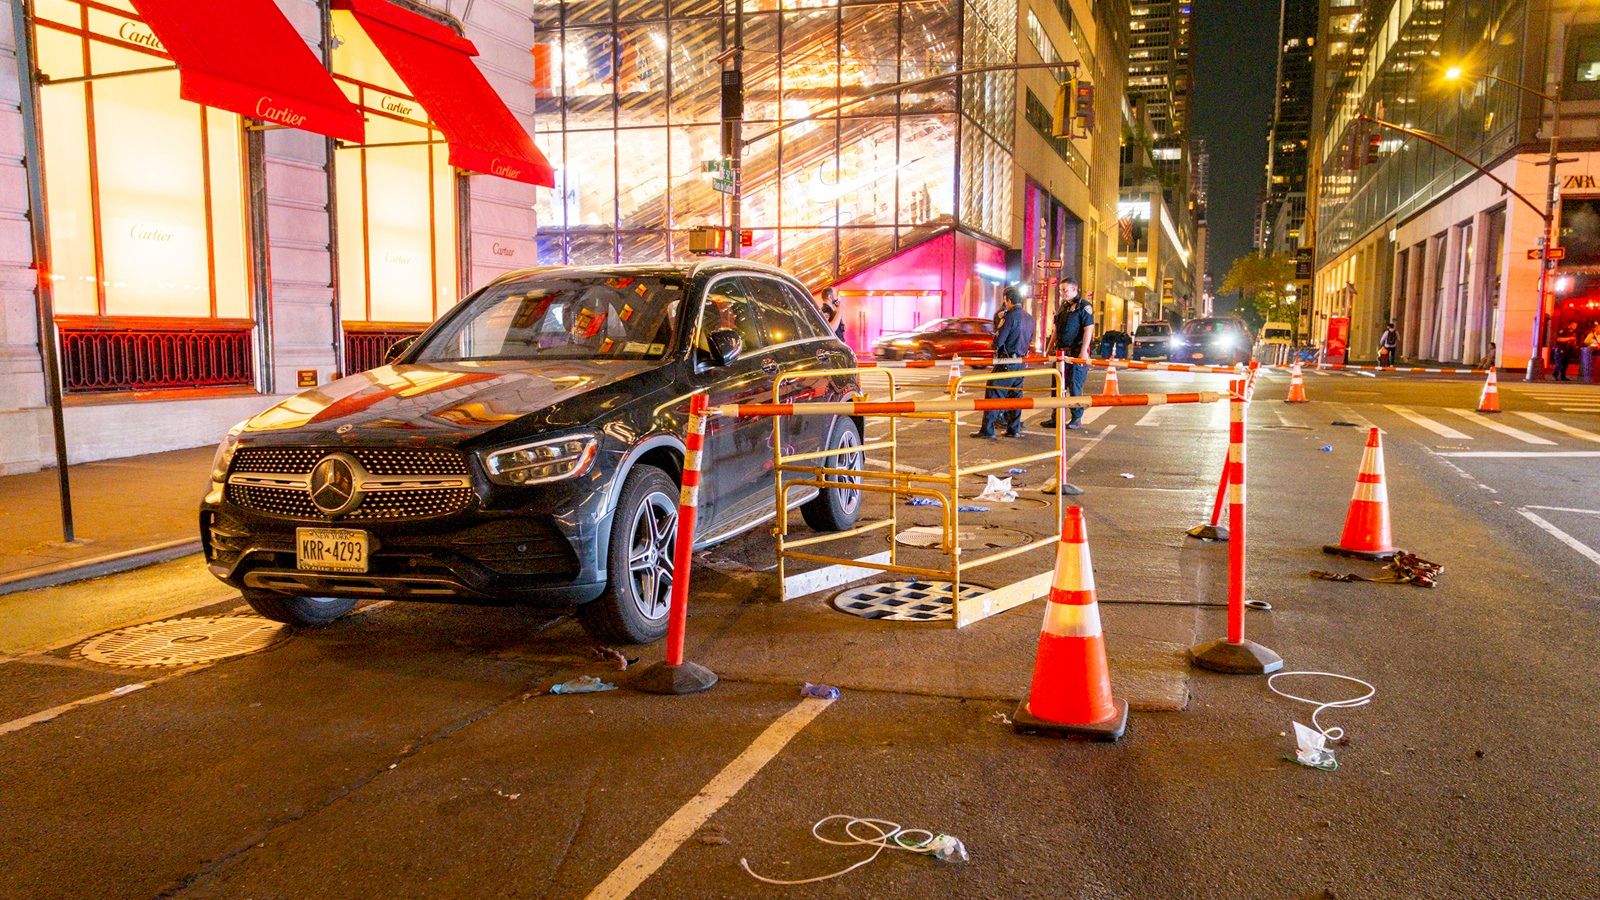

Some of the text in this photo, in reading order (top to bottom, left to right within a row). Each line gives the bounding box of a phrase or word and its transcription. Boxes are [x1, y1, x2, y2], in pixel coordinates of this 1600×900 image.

[119, 21, 163, 49] Cartie
[256, 96, 306, 126] Cartier
[381, 95, 412, 115] Cartier
[491, 158, 520, 178] Cartier
[1563, 175, 1596, 189] ZARA
[130, 224, 175, 242] Cartier
[492, 242, 515, 257] Cartier
